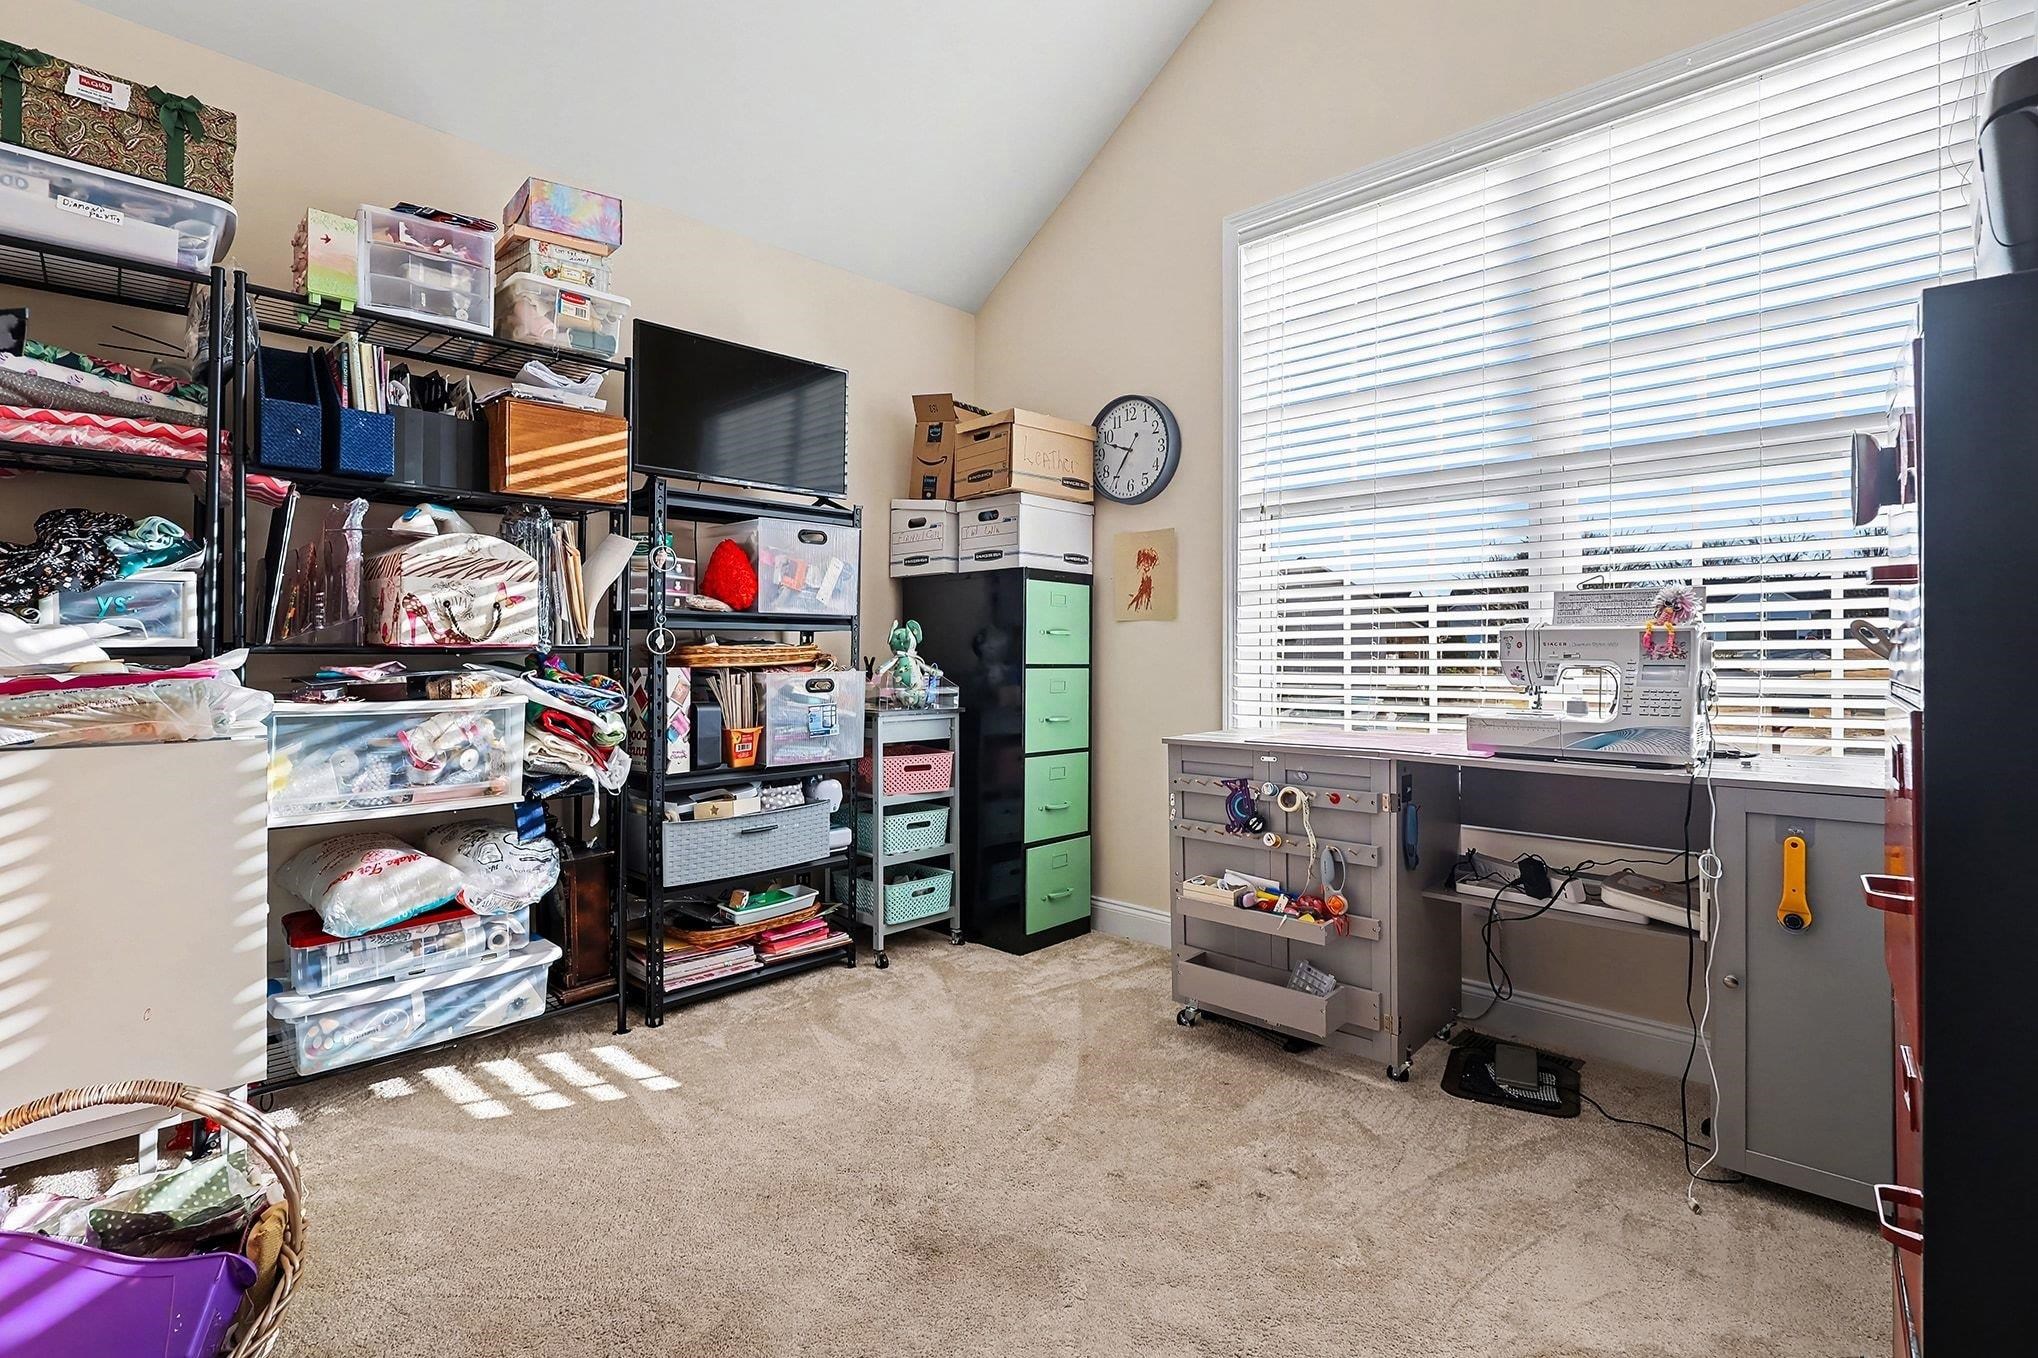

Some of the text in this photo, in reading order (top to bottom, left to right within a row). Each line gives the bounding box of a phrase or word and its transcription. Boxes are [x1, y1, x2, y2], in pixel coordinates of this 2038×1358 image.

[1124, 406, 1138, 422] 12
[1142, 408, 1149, 423] 1
[1113, 415, 1122, 430] 11
[1151, 420, 1160, 434] 2
[1103, 429, 1114, 444] 10
[1157, 438, 1166, 452] 3
[1098, 448, 1106, 462] 9
[1152, 456, 1160, 471] 4
[1102, 464, 1110, 478] 8
[1113, 475, 1121, 490] 7
[1126, 478, 1135, 492] 6
[1141, 472, 1149, 486] 5
